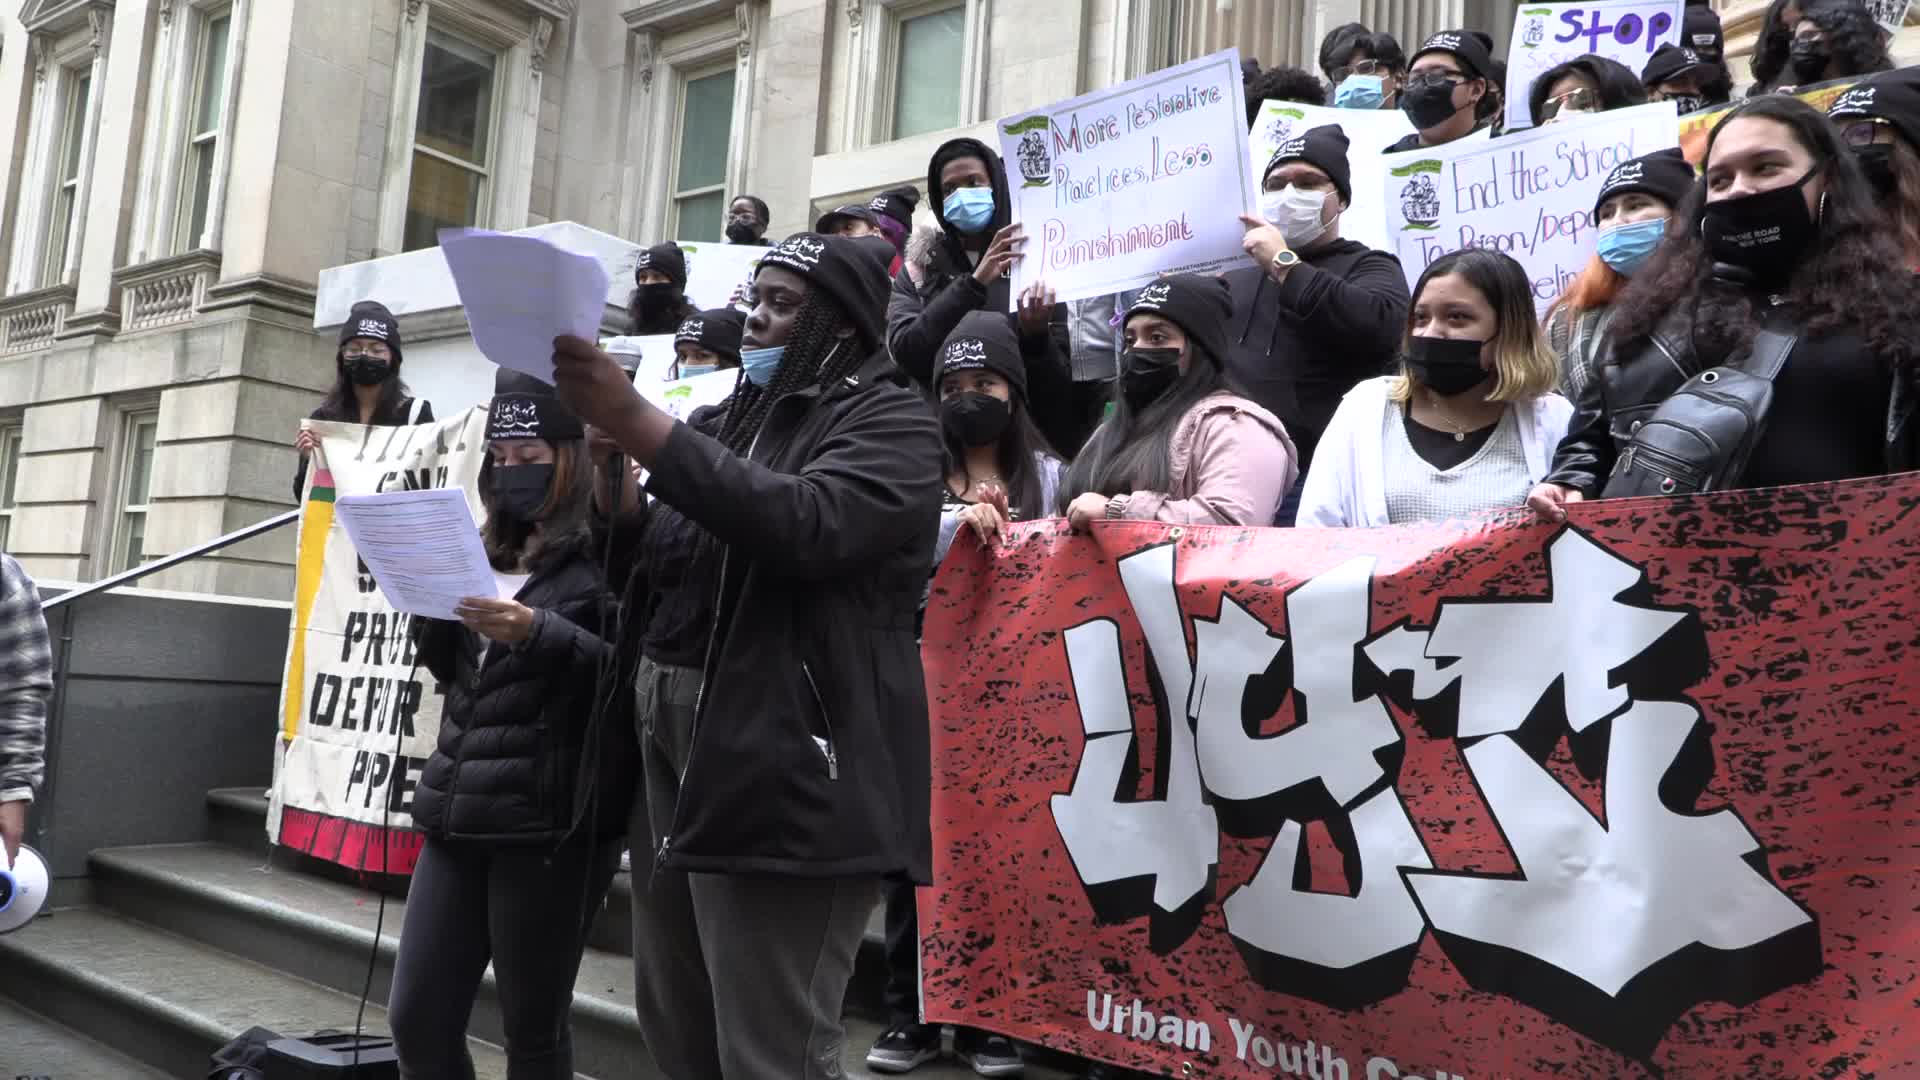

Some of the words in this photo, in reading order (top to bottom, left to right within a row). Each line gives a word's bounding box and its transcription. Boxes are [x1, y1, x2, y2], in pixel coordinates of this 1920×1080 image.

[1050, 112, 1120, 160] More
[1151, 136, 1213, 181] Less
[1452, 156, 1504, 214] End
[1505, 150, 1549, 200] the
[1555, 128, 1634, 188] School
[1040, 211, 1194, 276] Punishment
[1086, 989, 1211, 1052] Urban
[1228, 1017, 1349, 1080] Youth
